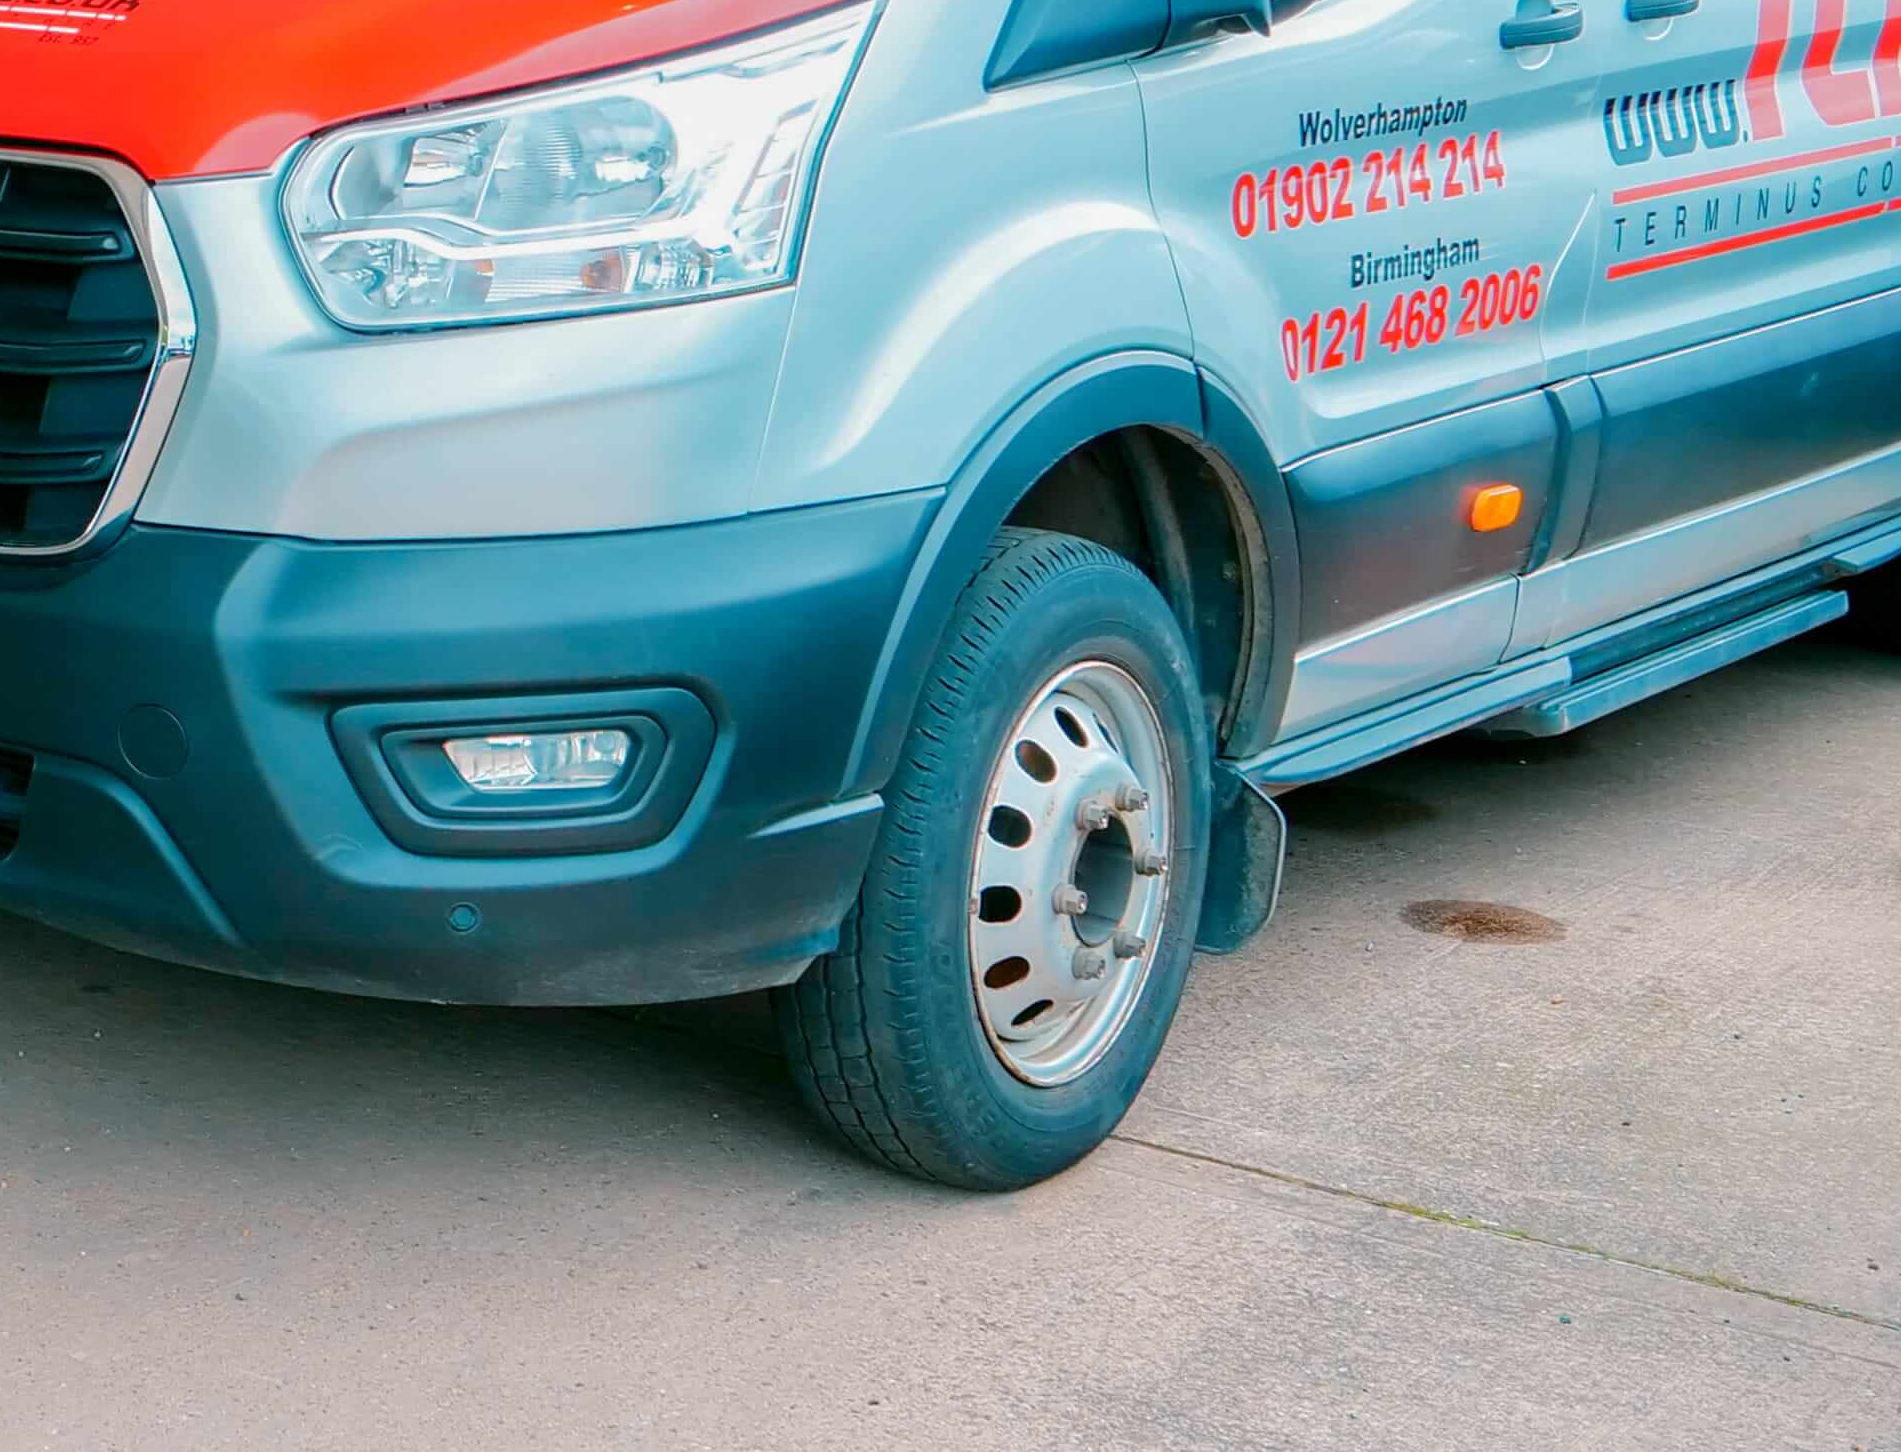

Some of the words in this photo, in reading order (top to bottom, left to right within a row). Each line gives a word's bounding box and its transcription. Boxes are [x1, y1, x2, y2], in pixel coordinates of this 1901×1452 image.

[1299, 96, 1468, 147] Wolverhampton
[1231, 156, 1355, 240] 01902
[1361, 142, 1432, 214] 214
[1436, 130, 1506, 200] 214
[1613, 175, 1823, 253] TERMINUS
[1350, 237, 1481, 289] Birmingham
[1280, 301, 1368, 382] 0121
[1378, 284, 1450, 354] 468
[1454, 263, 1542, 338] 2006
